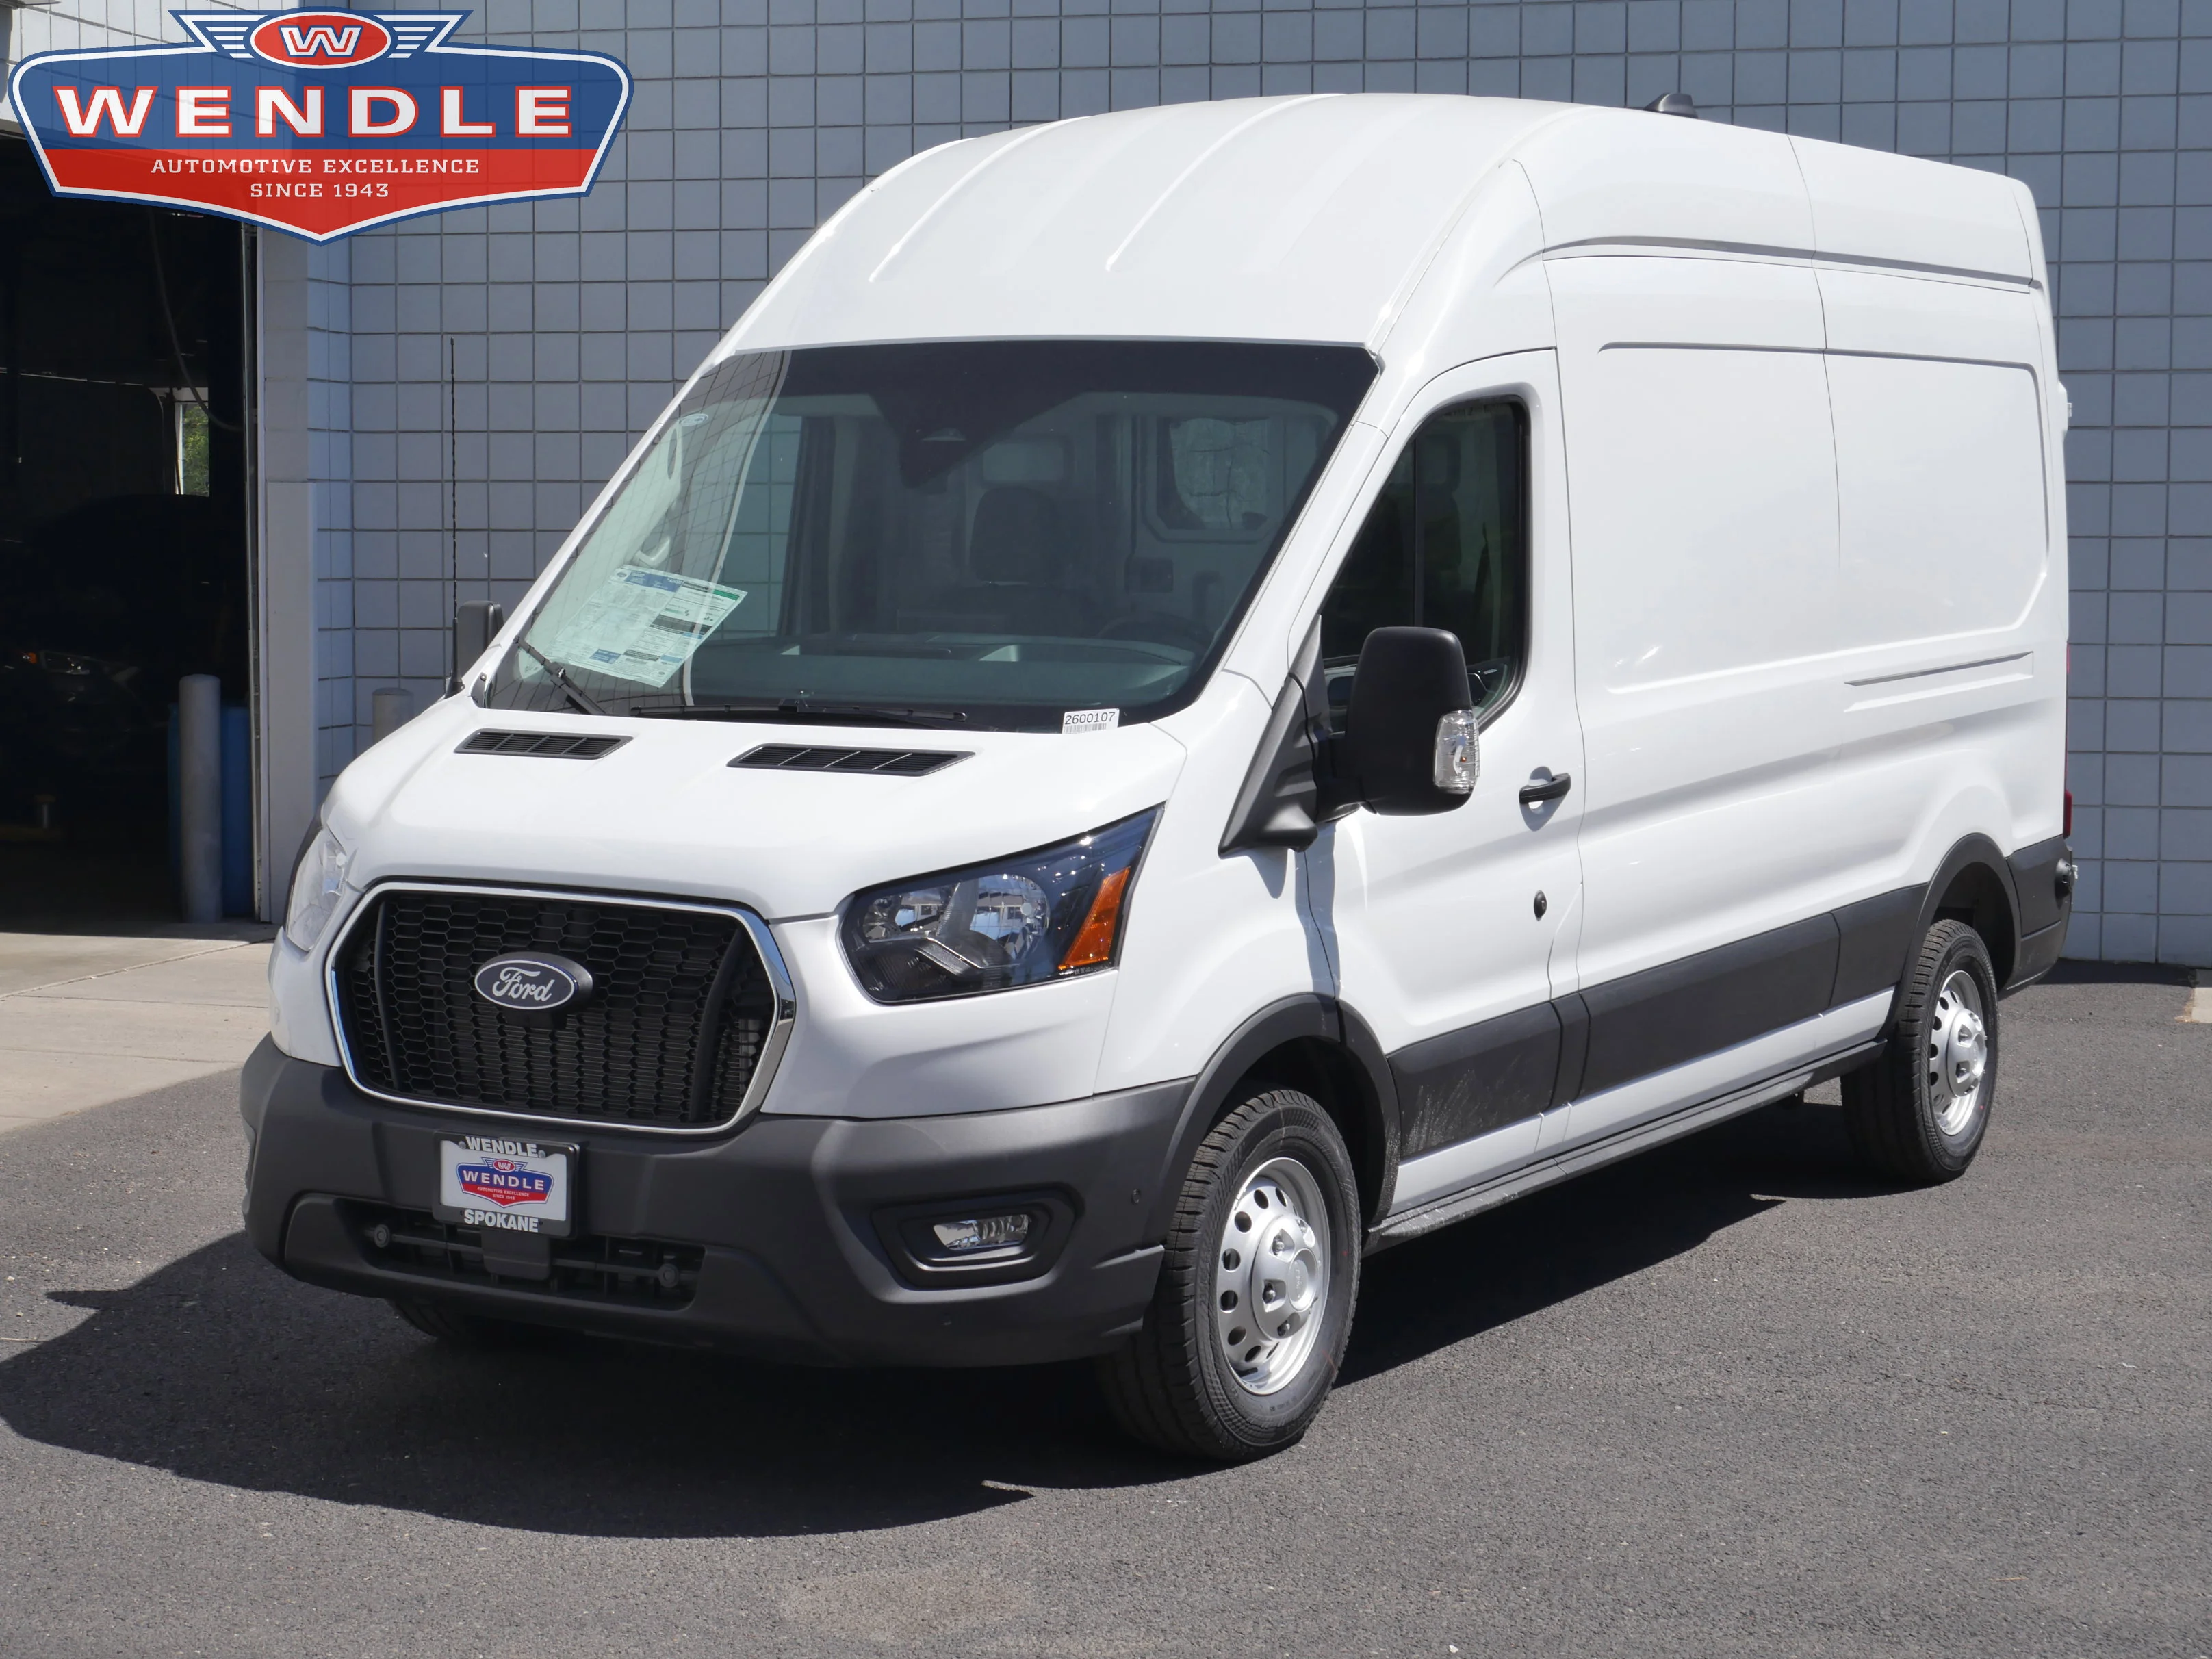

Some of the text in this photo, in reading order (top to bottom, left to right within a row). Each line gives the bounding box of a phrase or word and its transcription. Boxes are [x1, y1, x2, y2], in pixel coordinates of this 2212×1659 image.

[1064, 712, 1116, 725] 2600107
[492, 966, 555, 1002] Ford
[465, 1136, 538, 1157] WENDLE
[463, 1170, 544, 1191] WENDLE
[464, 1209, 539, 1232] SPOKANE
